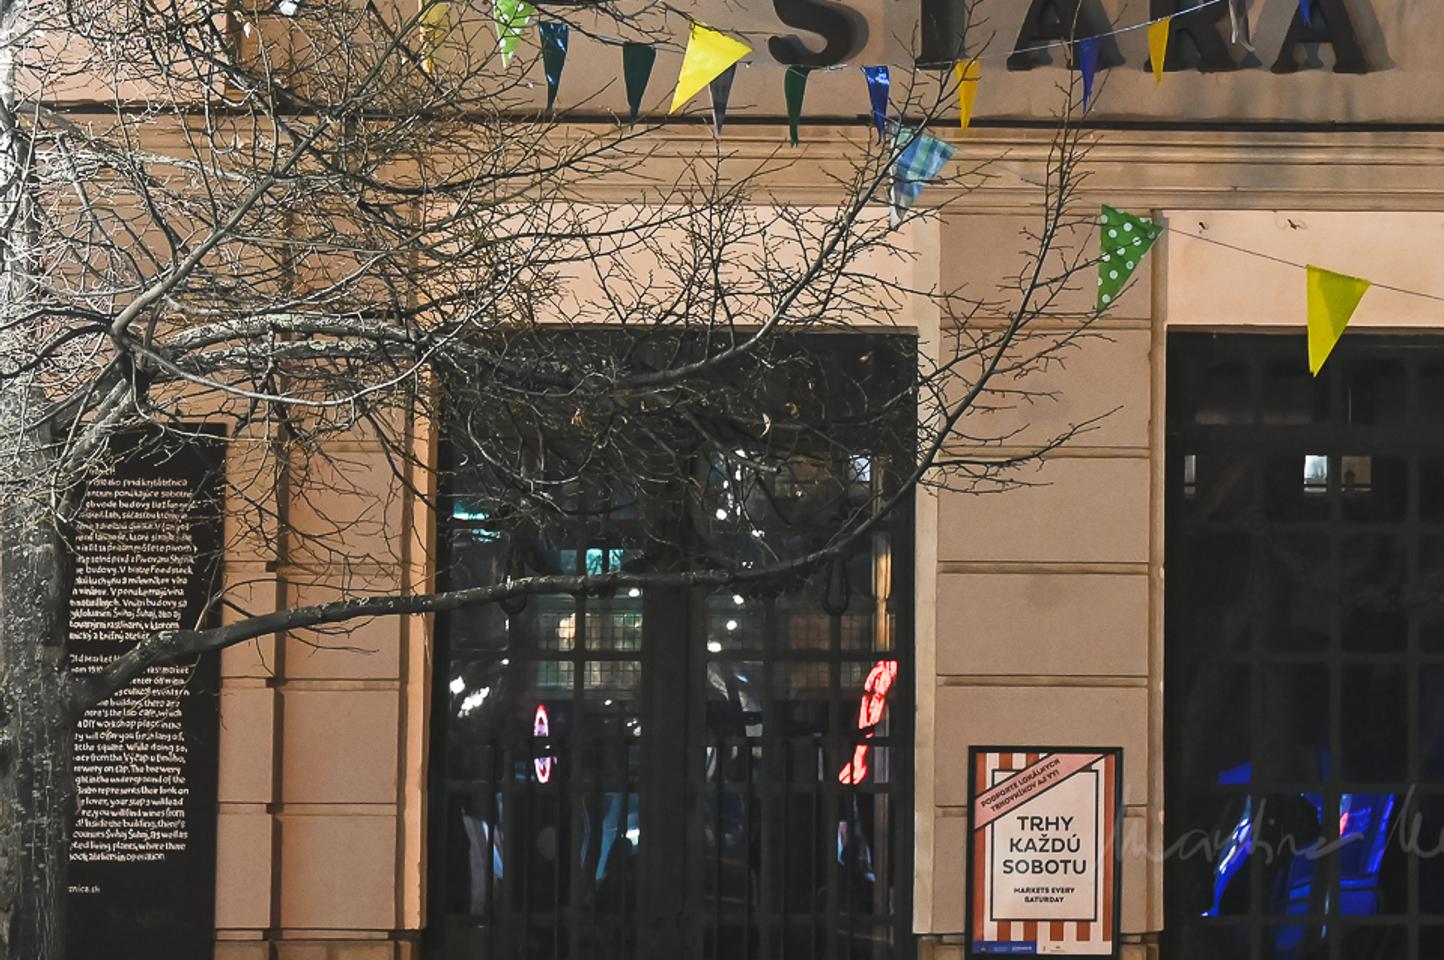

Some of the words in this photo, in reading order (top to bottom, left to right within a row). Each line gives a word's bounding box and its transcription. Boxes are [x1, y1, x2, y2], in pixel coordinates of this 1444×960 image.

[1017, 816, 1074, 831] TRHY
[1009, 834, 1080, 853] KAŽDÚ
[1002, 859, 1087, 875] SOBOTU
[1014, 886, 1050, 894] MARKETS
[1051, 886, 1075, 894] EVERY
[1024, 896, 1064, 904] SATURDAY
